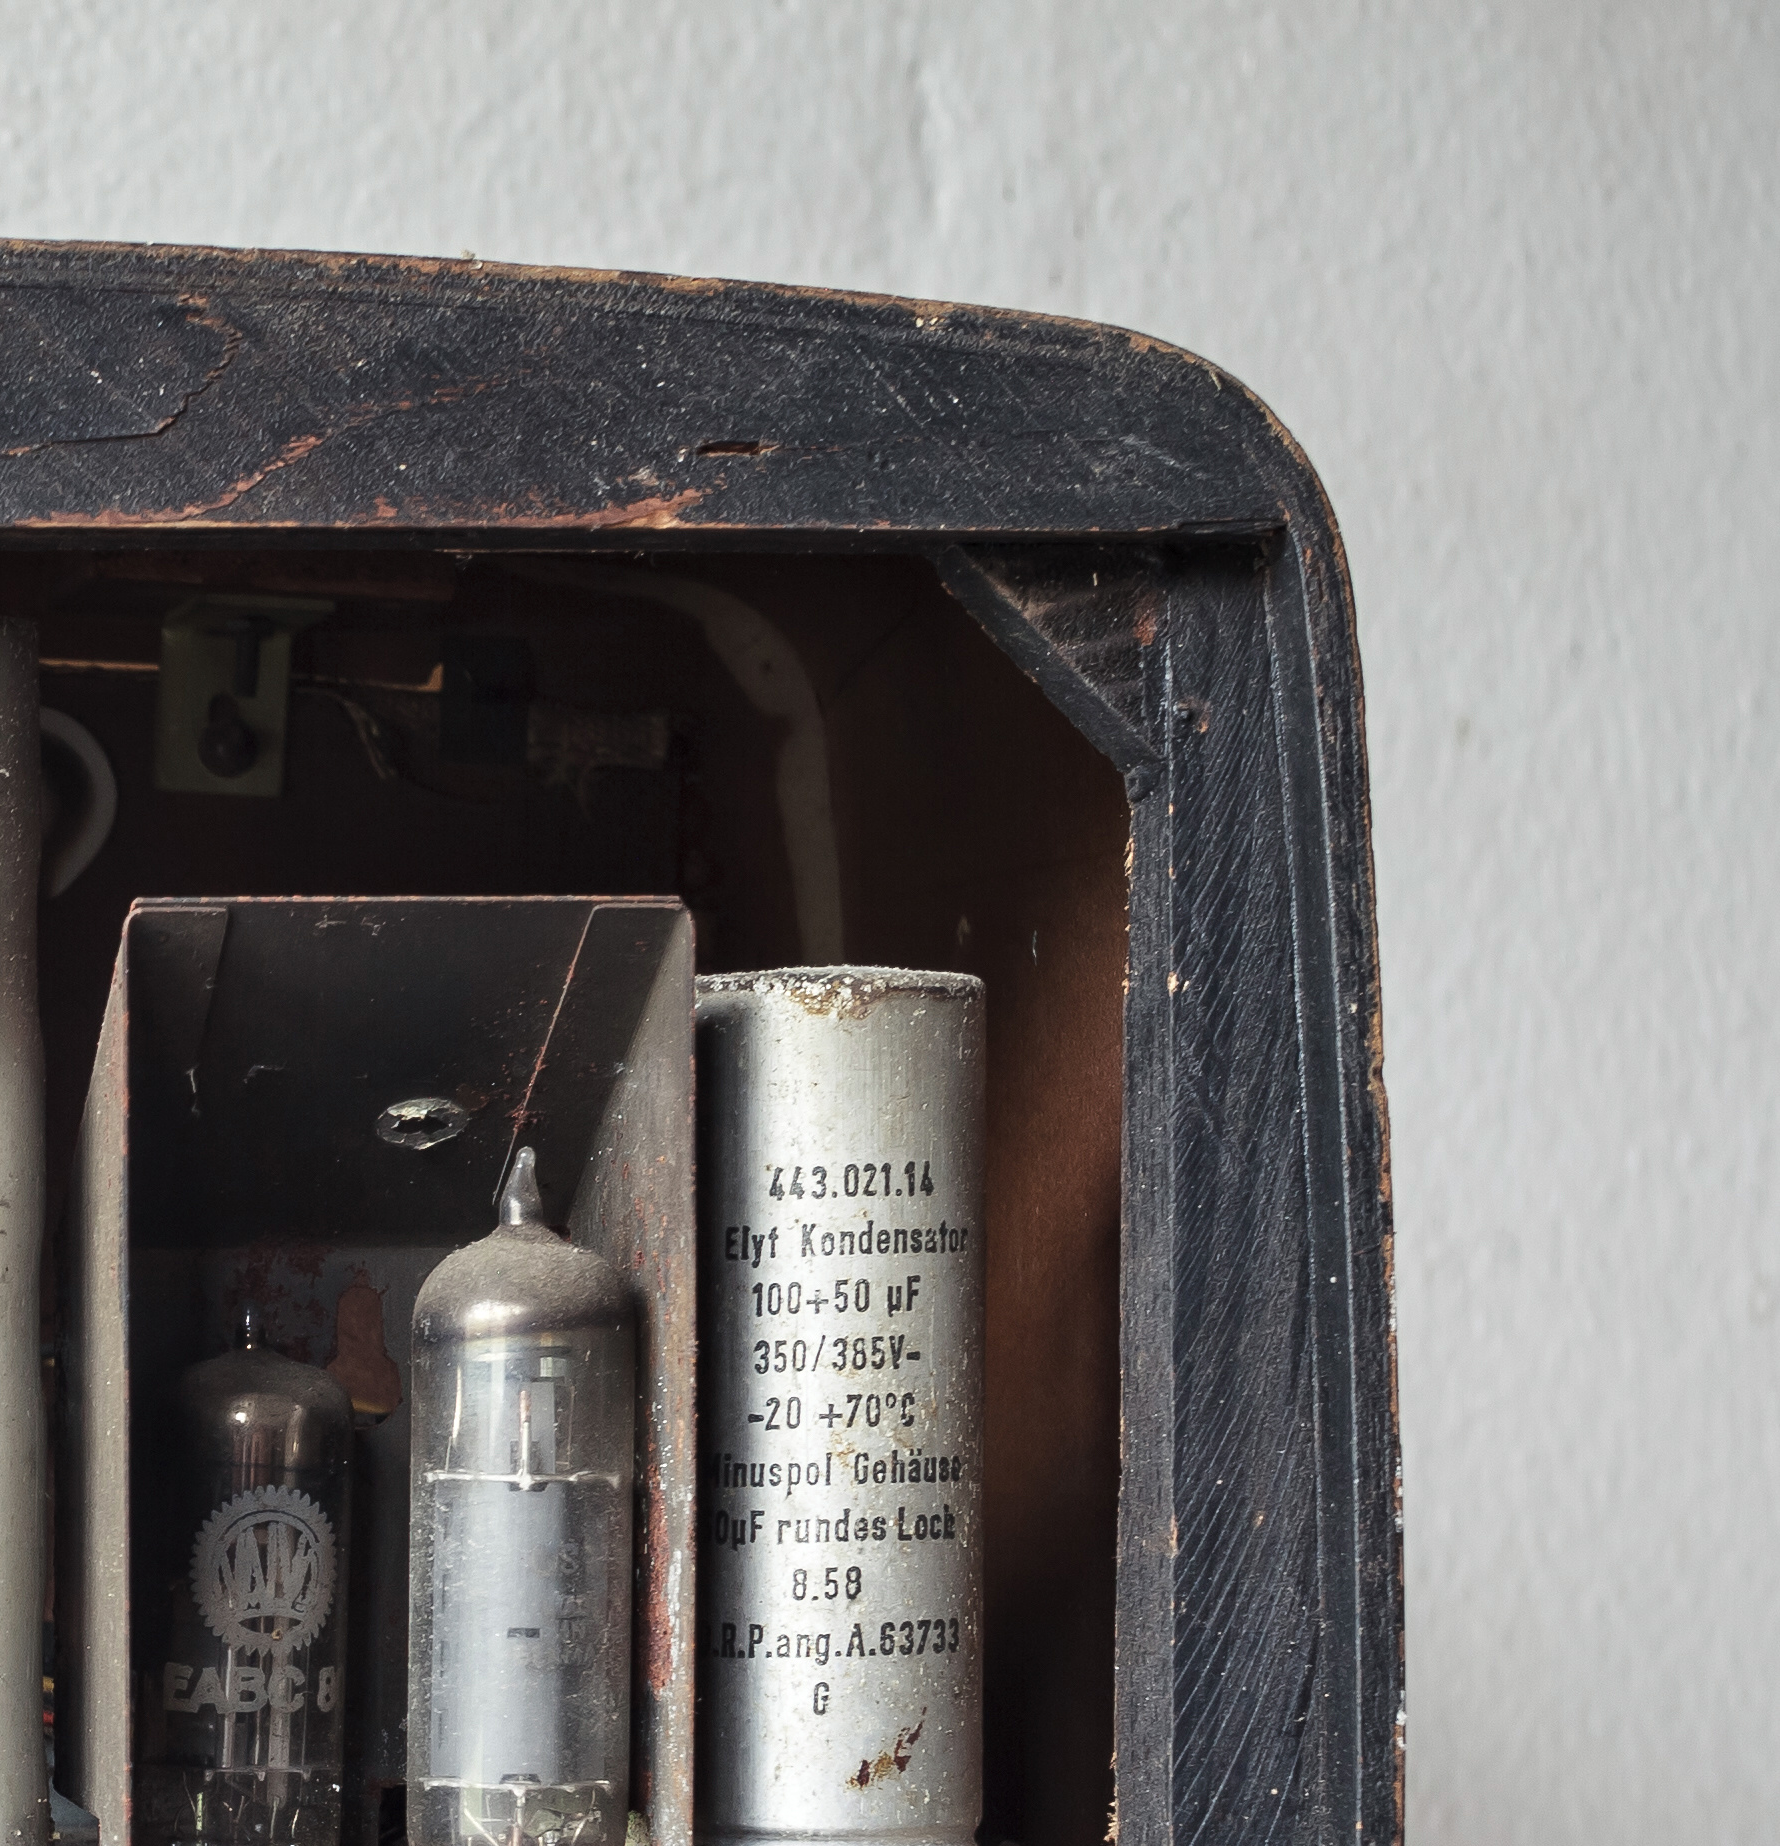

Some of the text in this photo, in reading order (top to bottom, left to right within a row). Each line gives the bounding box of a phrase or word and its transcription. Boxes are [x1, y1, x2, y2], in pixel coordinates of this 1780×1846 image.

[769, 1161, 935, 1201] 443.021.14
[801, 1220, 969, 1257] Kondensator
[752, 1278, 871, 1317] 100+50
[748, 1392, 916, 1431] -20 +70°C
[777, 1508, 887, 1545] rundes
[792, 1566, 863, 1602] 8.58
[163, 1661, 306, 1714] EABC
[812, 1681, 831, 1715] G
